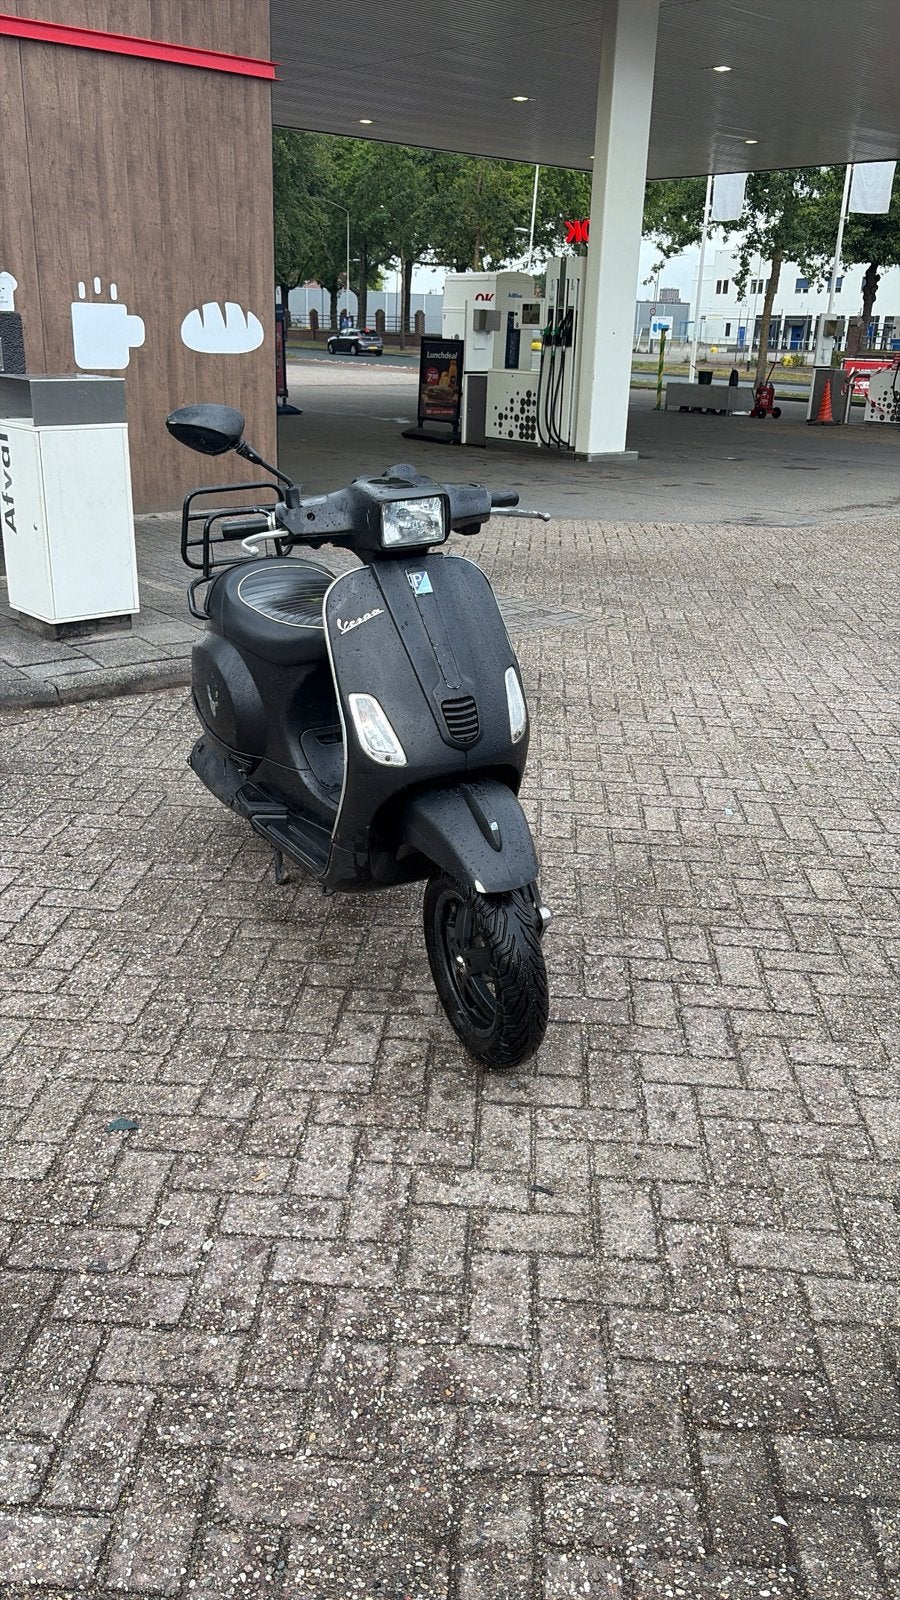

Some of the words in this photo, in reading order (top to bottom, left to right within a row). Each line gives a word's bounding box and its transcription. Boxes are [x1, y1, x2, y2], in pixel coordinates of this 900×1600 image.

[427, 351, 458, 359] Lunchdeal
[0, 433, 17, 534] Afval
[337, 608, 385, 635] Vespa
